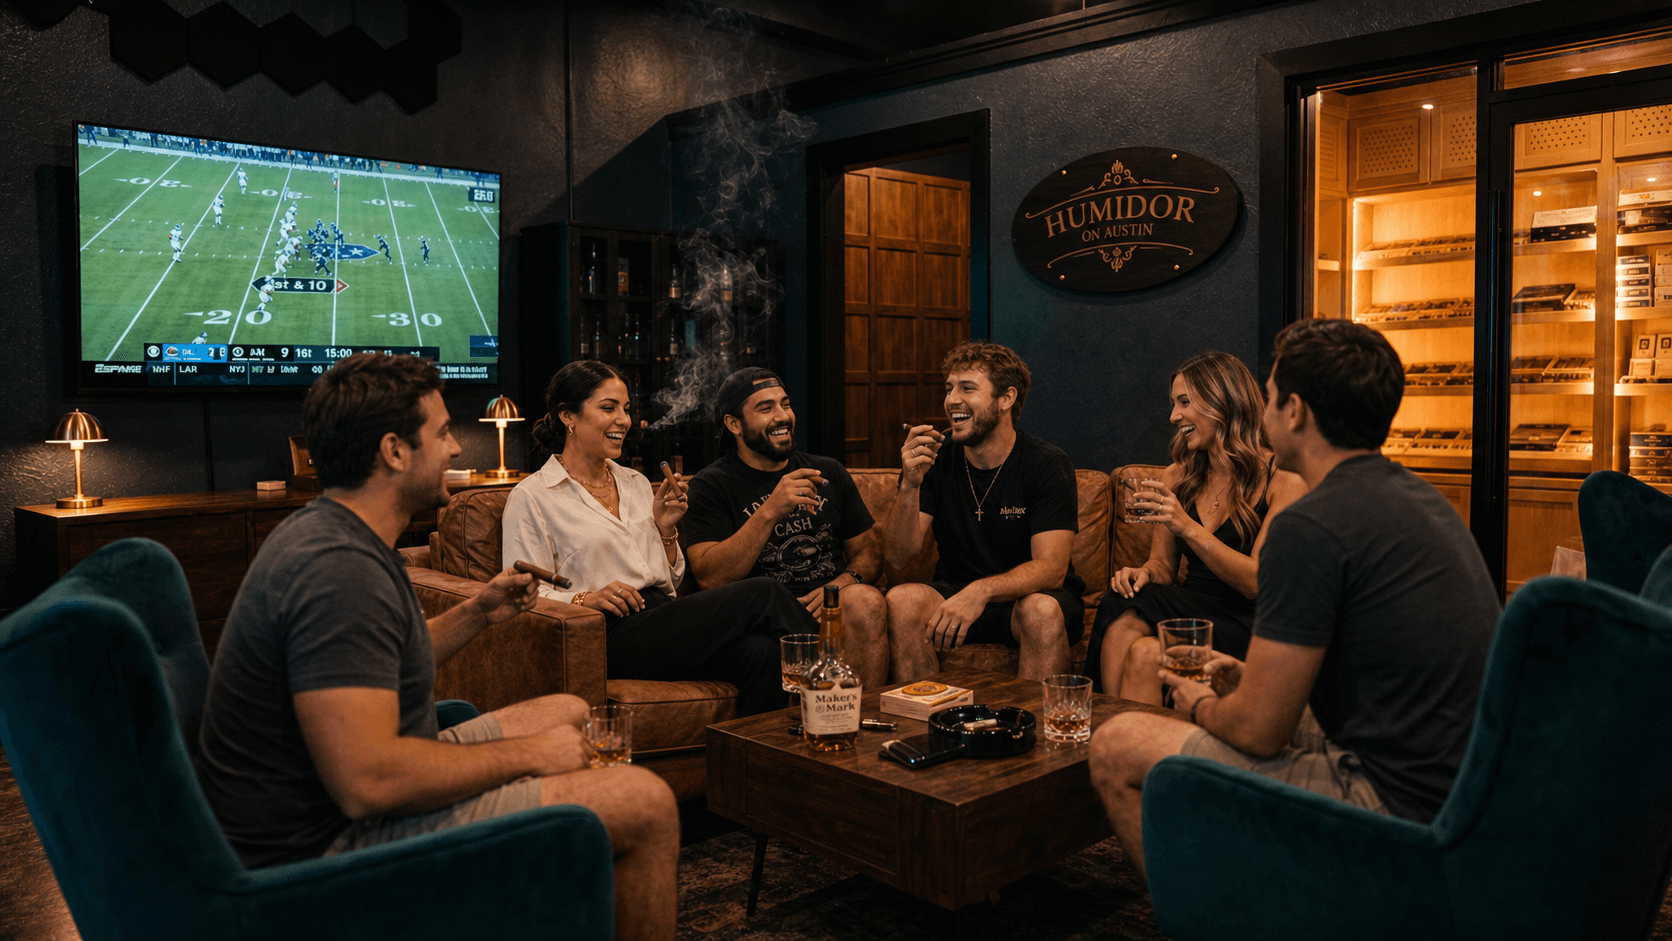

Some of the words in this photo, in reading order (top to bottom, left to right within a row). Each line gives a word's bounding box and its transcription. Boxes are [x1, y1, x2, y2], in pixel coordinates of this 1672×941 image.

[1044, 194, 1195, 238] HUMIDOR
[1081, 227, 1101, 242] ON
[1104, 222, 1154, 239] AUSTIN
[293, 280, 304, 290] &
[308, 280, 327, 290] 10
[281, 347, 289, 358] 9
[324, 348, 353, 358] 15:00
[179, 365, 198, 373] LAR
[229, 365, 245, 373] NYJ
[774, 516, 813, 537] CASH
[815, 693, 858, 703] Maker's
[826, 702, 856, 712] Mark
